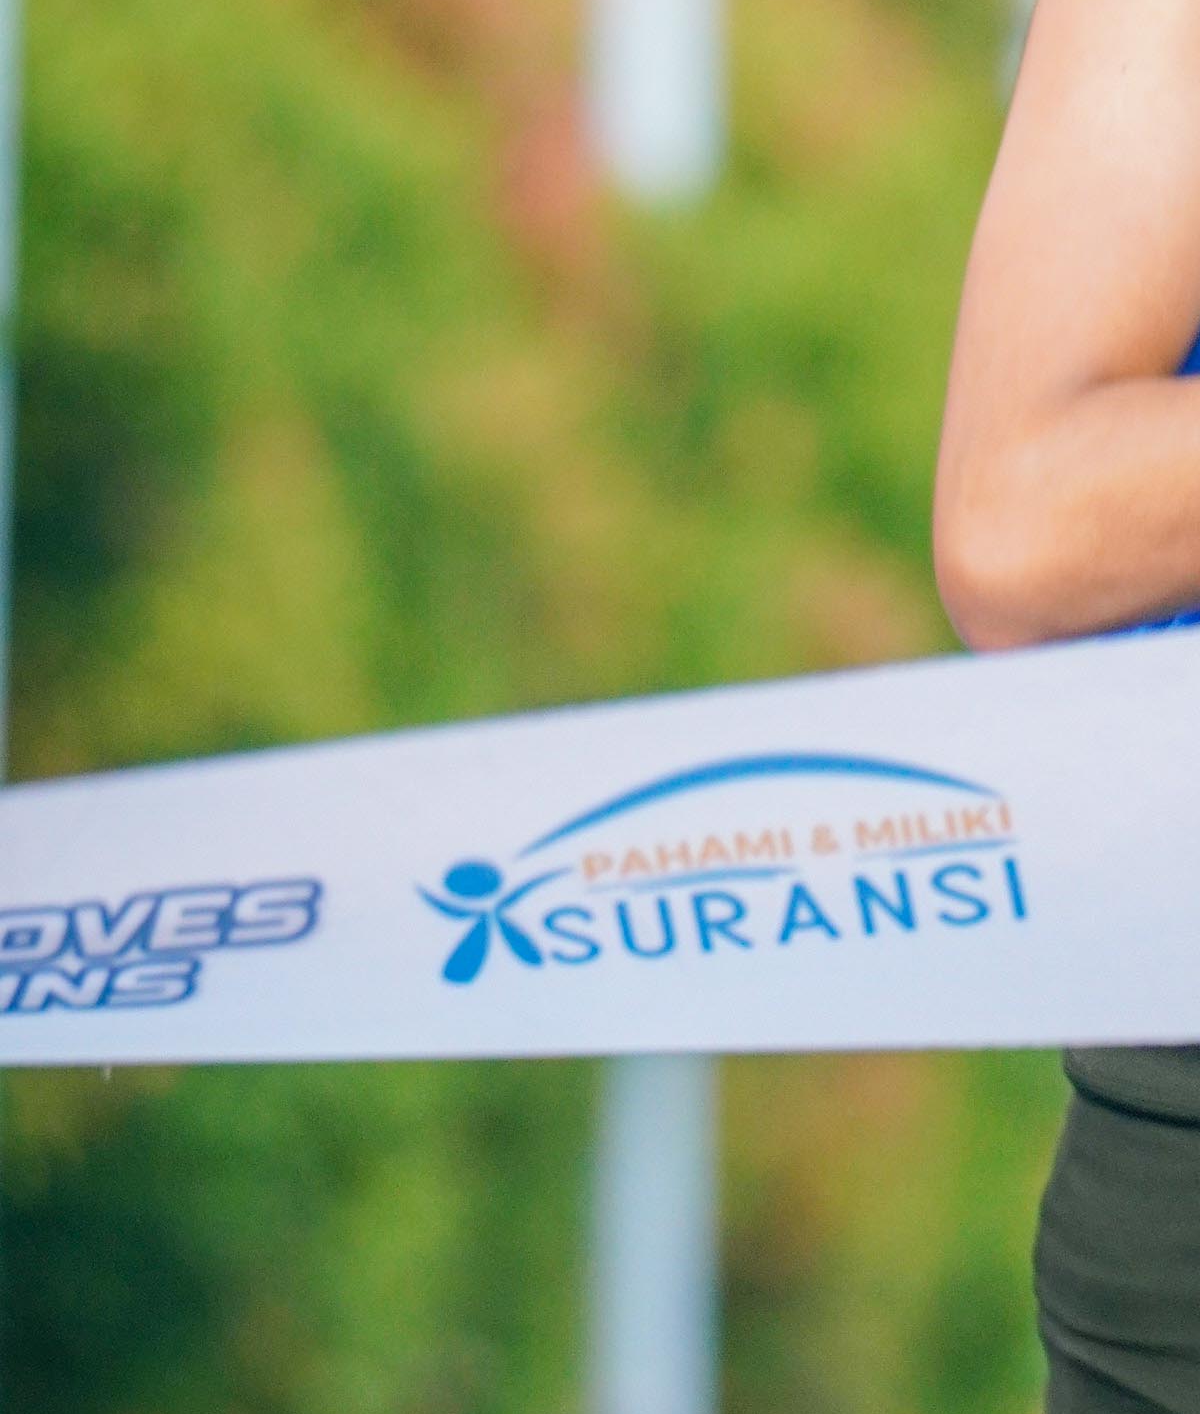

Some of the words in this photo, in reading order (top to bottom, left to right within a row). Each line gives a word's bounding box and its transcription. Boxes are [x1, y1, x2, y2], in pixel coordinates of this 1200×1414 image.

[580, 829, 793, 882] PAHAMI
[811, 824, 839, 857] &
[853, 800, 1012, 847] MILIKI
